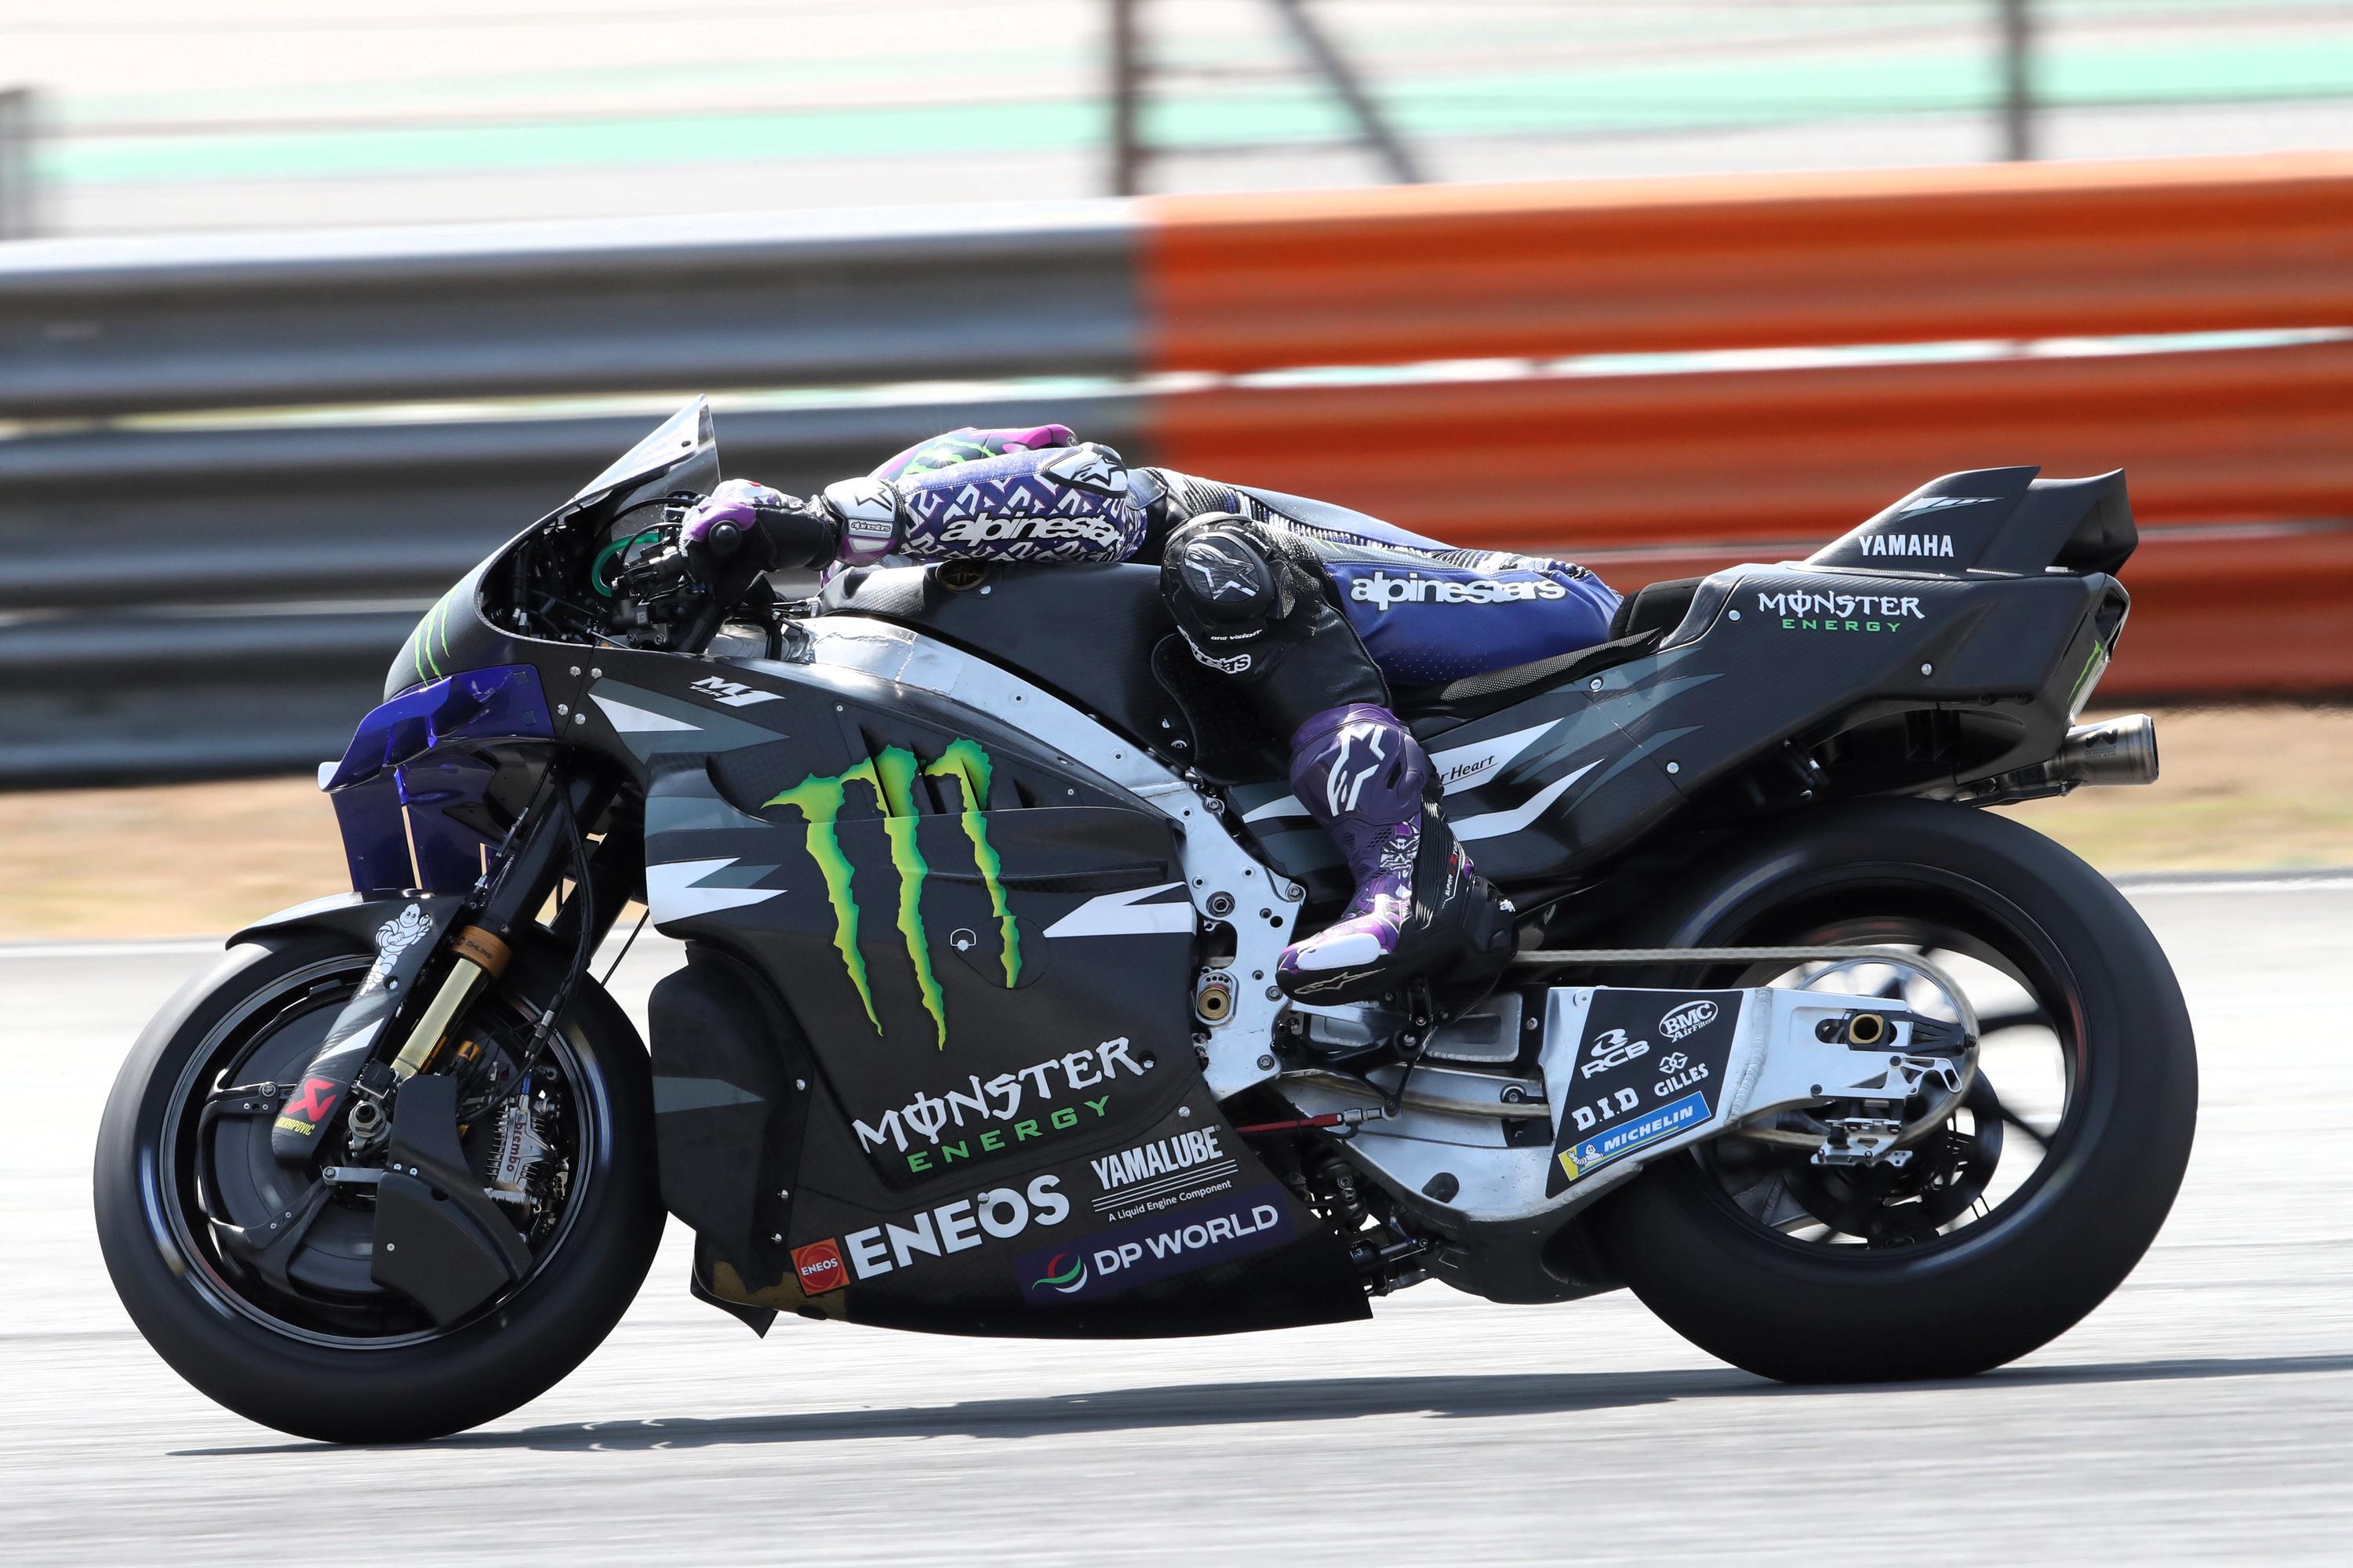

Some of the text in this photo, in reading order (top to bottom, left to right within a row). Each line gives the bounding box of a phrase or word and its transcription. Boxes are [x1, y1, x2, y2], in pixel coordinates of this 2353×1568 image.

[940, 511, 1122, 548] alpinestar
[1858, 534, 1954, 558] YAMAHA
[1351, 571, 1566, 611] alpinestars
[1757, 590, 1926, 620] MONSTER
[1782, 618, 1901, 633] ENERGY
[1450, 755, 1496, 780] Heart
[1663, 1003, 1713, 1035] BMC
[1580, 1040, 1650, 1079] RCB
[852, 1037, 1147, 1154] MONSTER
[1654, 1063, 1709, 1097] GILLES
[1571, 1087, 1639, 1131] D.I.D
[1604, 1105, 1693, 1152] MICHELIN
[506, 1122, 526, 1173] brembo
[907, 1095, 1110, 1173] ENERGY
[1108, 1180, 1232, 1222] A Liquid Engine Component
[844, 1174, 1070, 1280] ENEOS
[1093, 1205, 1278, 1276] DP WORLD
[800, 1257, 838, 1277] ENEOS
